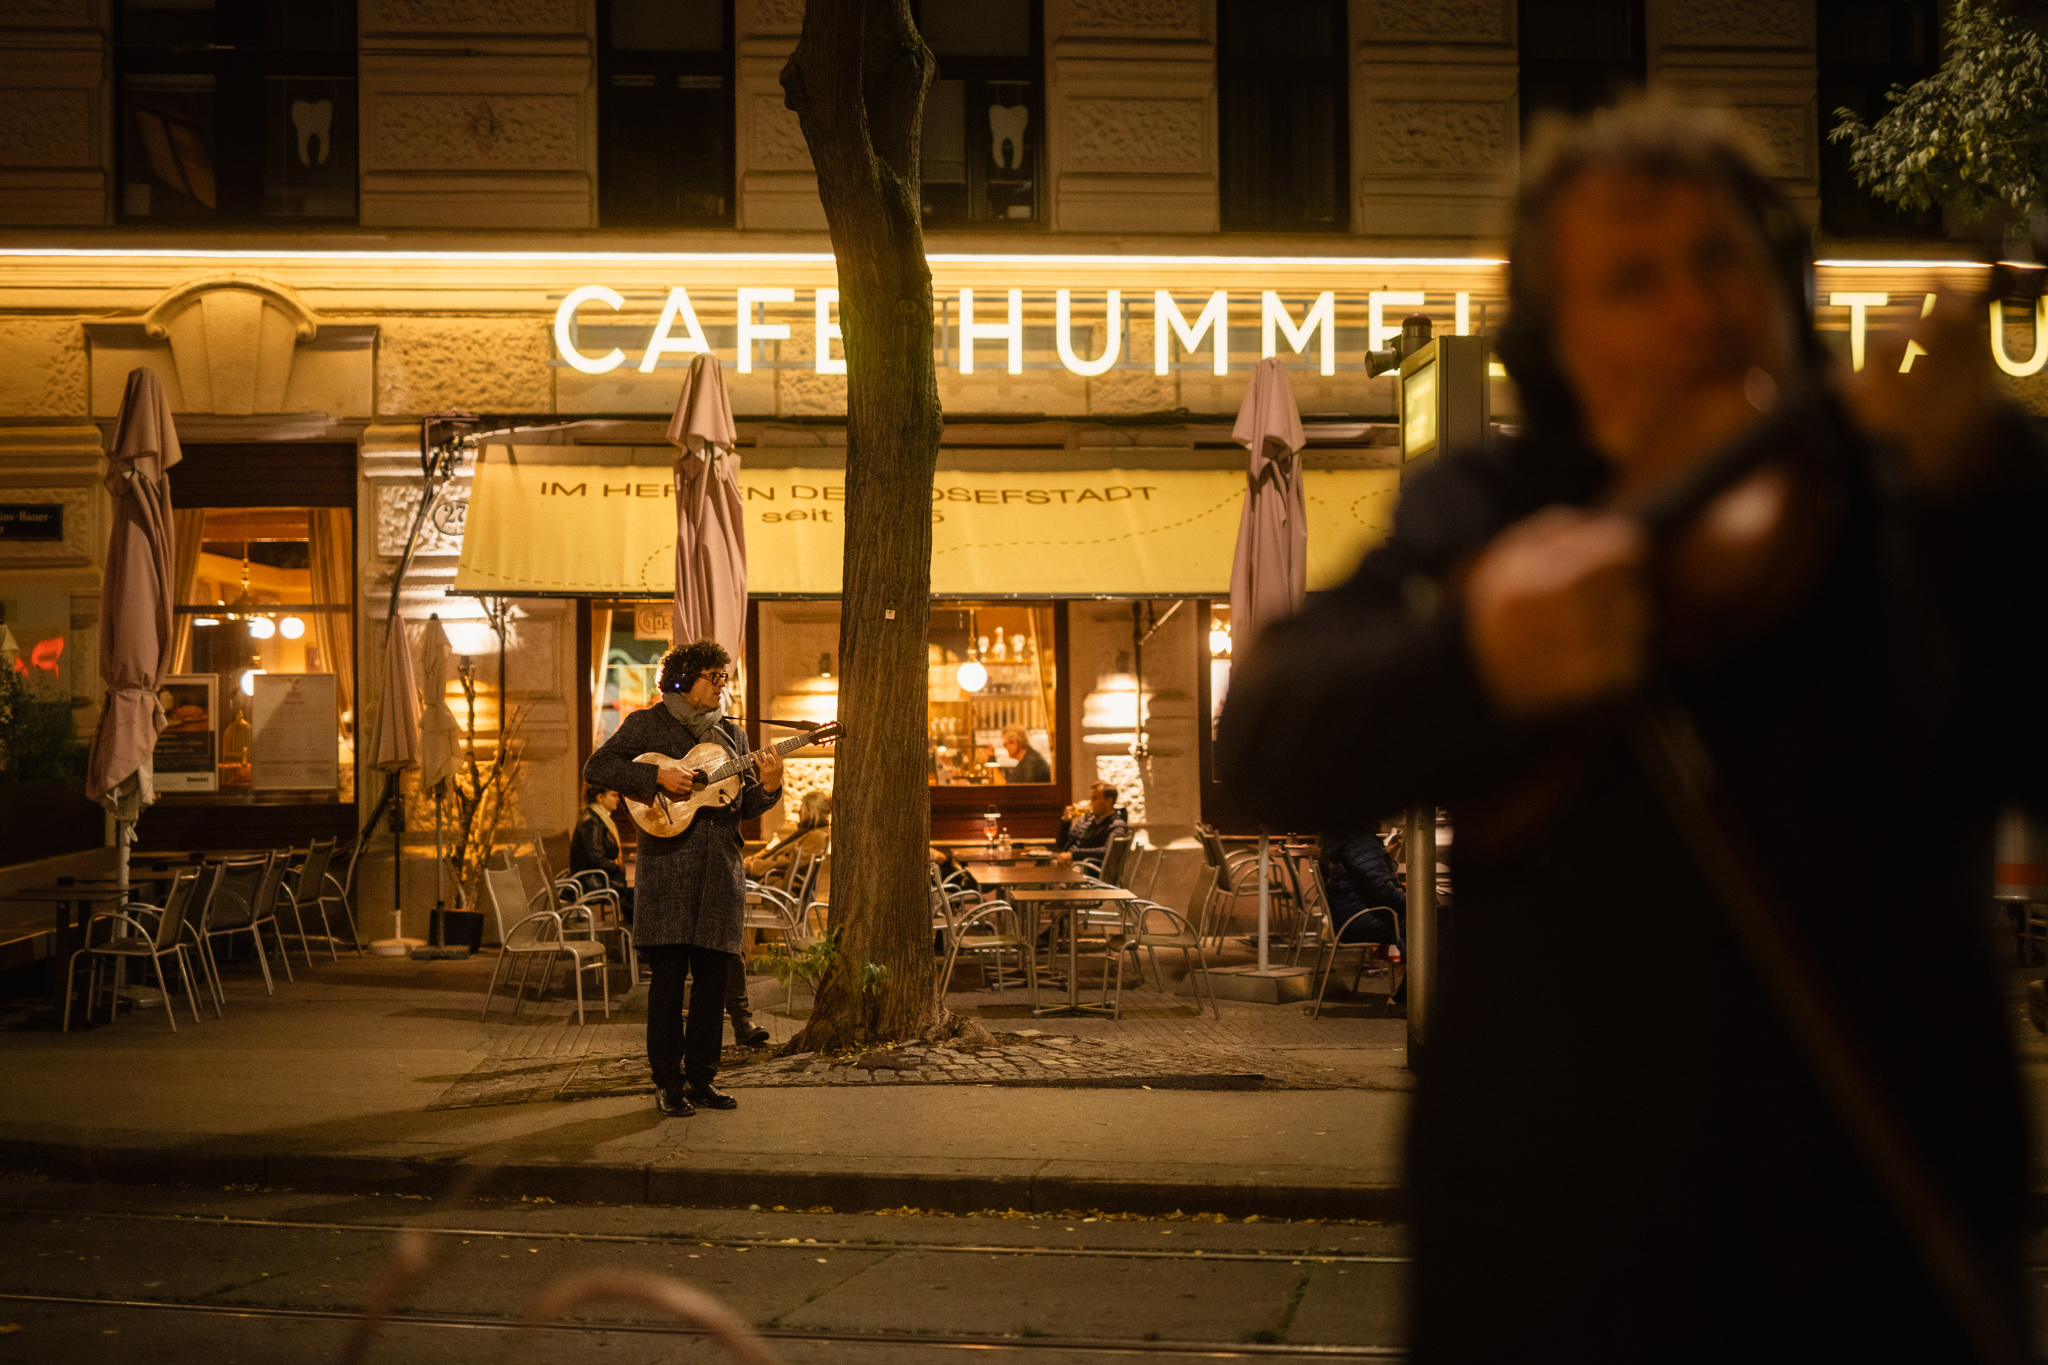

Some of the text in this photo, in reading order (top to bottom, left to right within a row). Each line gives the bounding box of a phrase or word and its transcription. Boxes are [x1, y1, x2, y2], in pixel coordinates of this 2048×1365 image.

[554, 285, 848, 374] CAFE
[541, 482, 586, 496] IM
[791, 485, 846, 501] DE
[932, 486, 1158, 504] SEFSTADT
[444, 504, 466, 523] 27
[761, 508, 834, 523] seit
